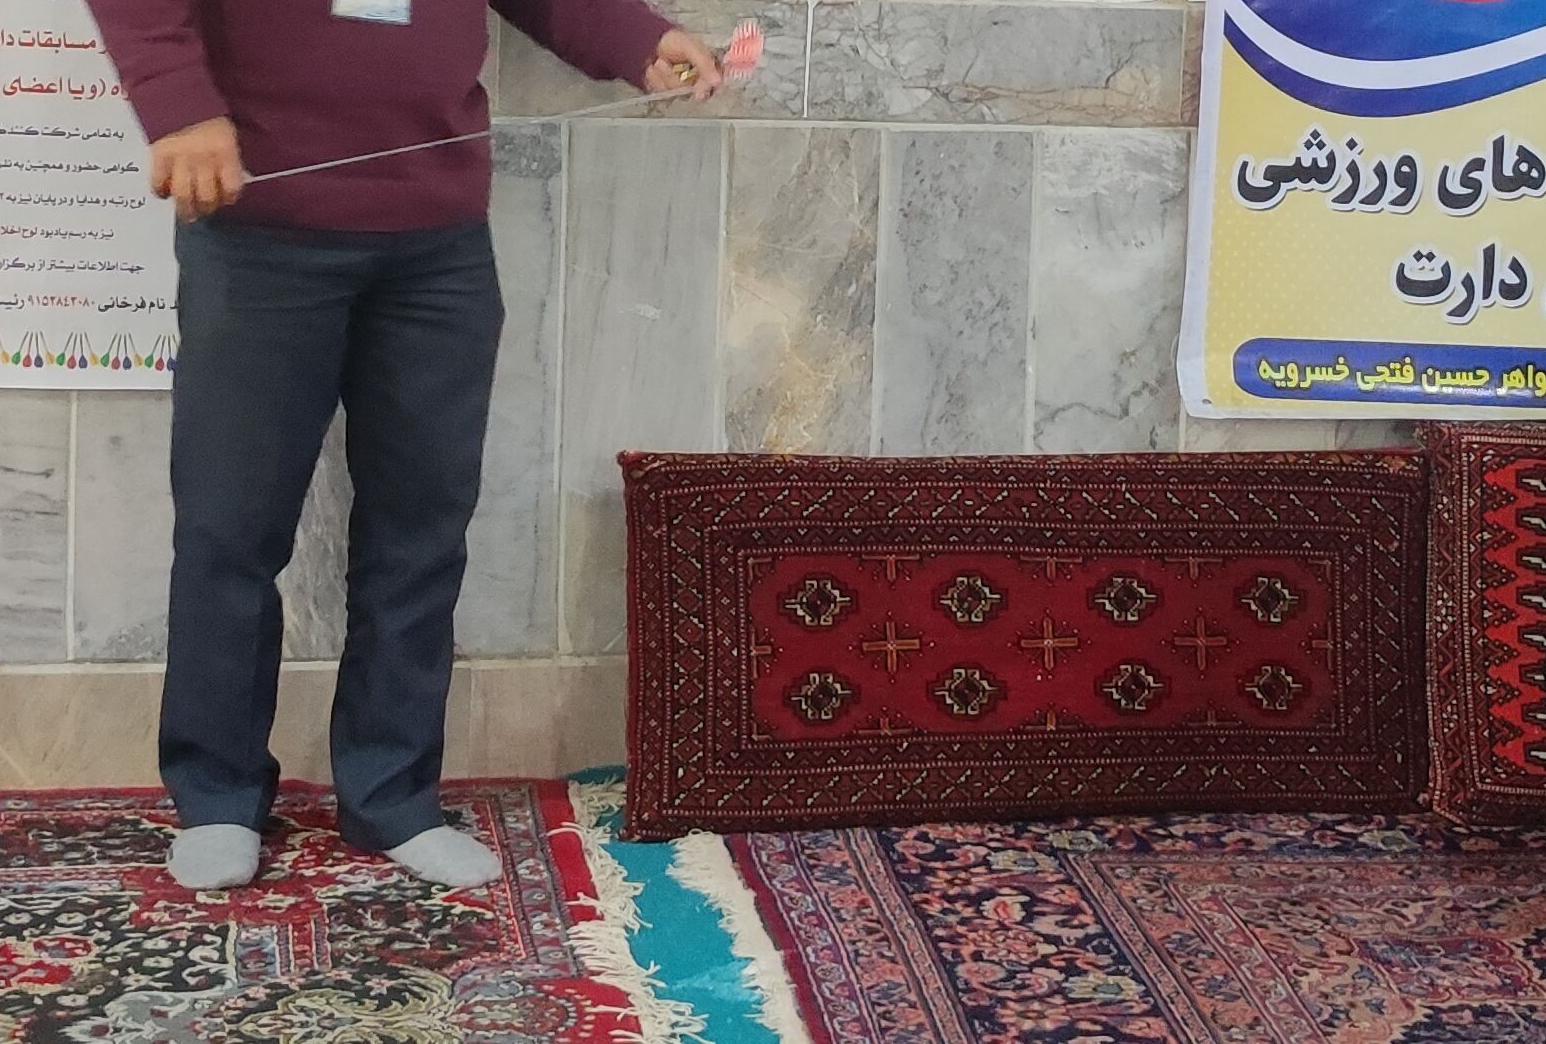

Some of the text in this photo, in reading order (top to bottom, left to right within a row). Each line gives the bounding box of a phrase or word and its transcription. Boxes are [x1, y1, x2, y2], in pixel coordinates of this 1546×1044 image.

[17, 30, 97, 54] مسابقات
[1235, 129, 1417, 211] ورزشی
[1396, 244, 1530, 321] دارت
[1259, 356, 1350, 389] خسرویه
[1356, 357, 1415, 391] فتحی
[1422, 370, 1490, 393] حسین
